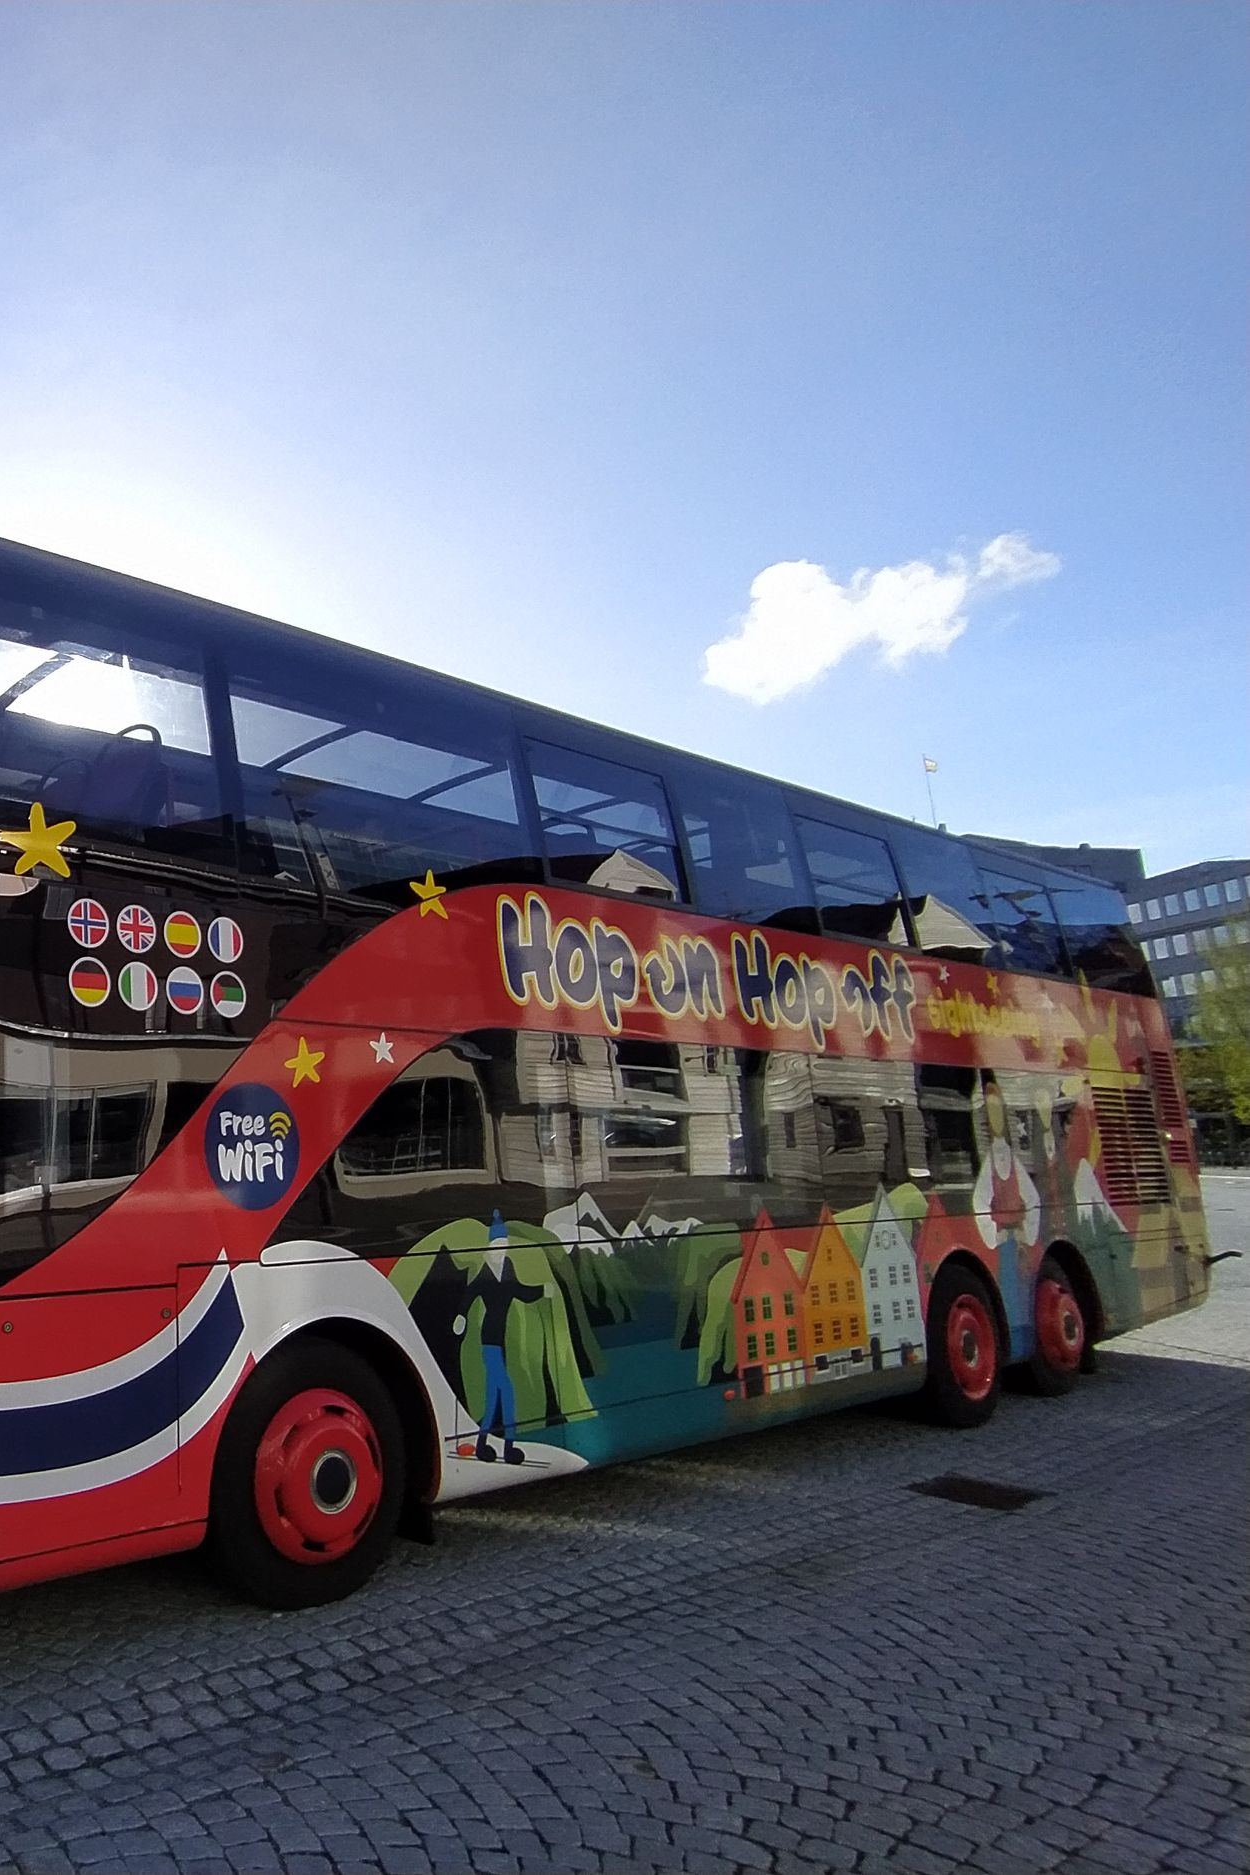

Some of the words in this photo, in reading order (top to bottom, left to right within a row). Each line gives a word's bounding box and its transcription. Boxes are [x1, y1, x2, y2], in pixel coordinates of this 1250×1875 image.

[498, 892, 638, 1033] Hop
[731, 930, 837, 1051] Hop
[840, 948, 916, 1044] off
[219, 1111, 266, 1136] Free
[217, 1139, 284, 1182] WiFi
